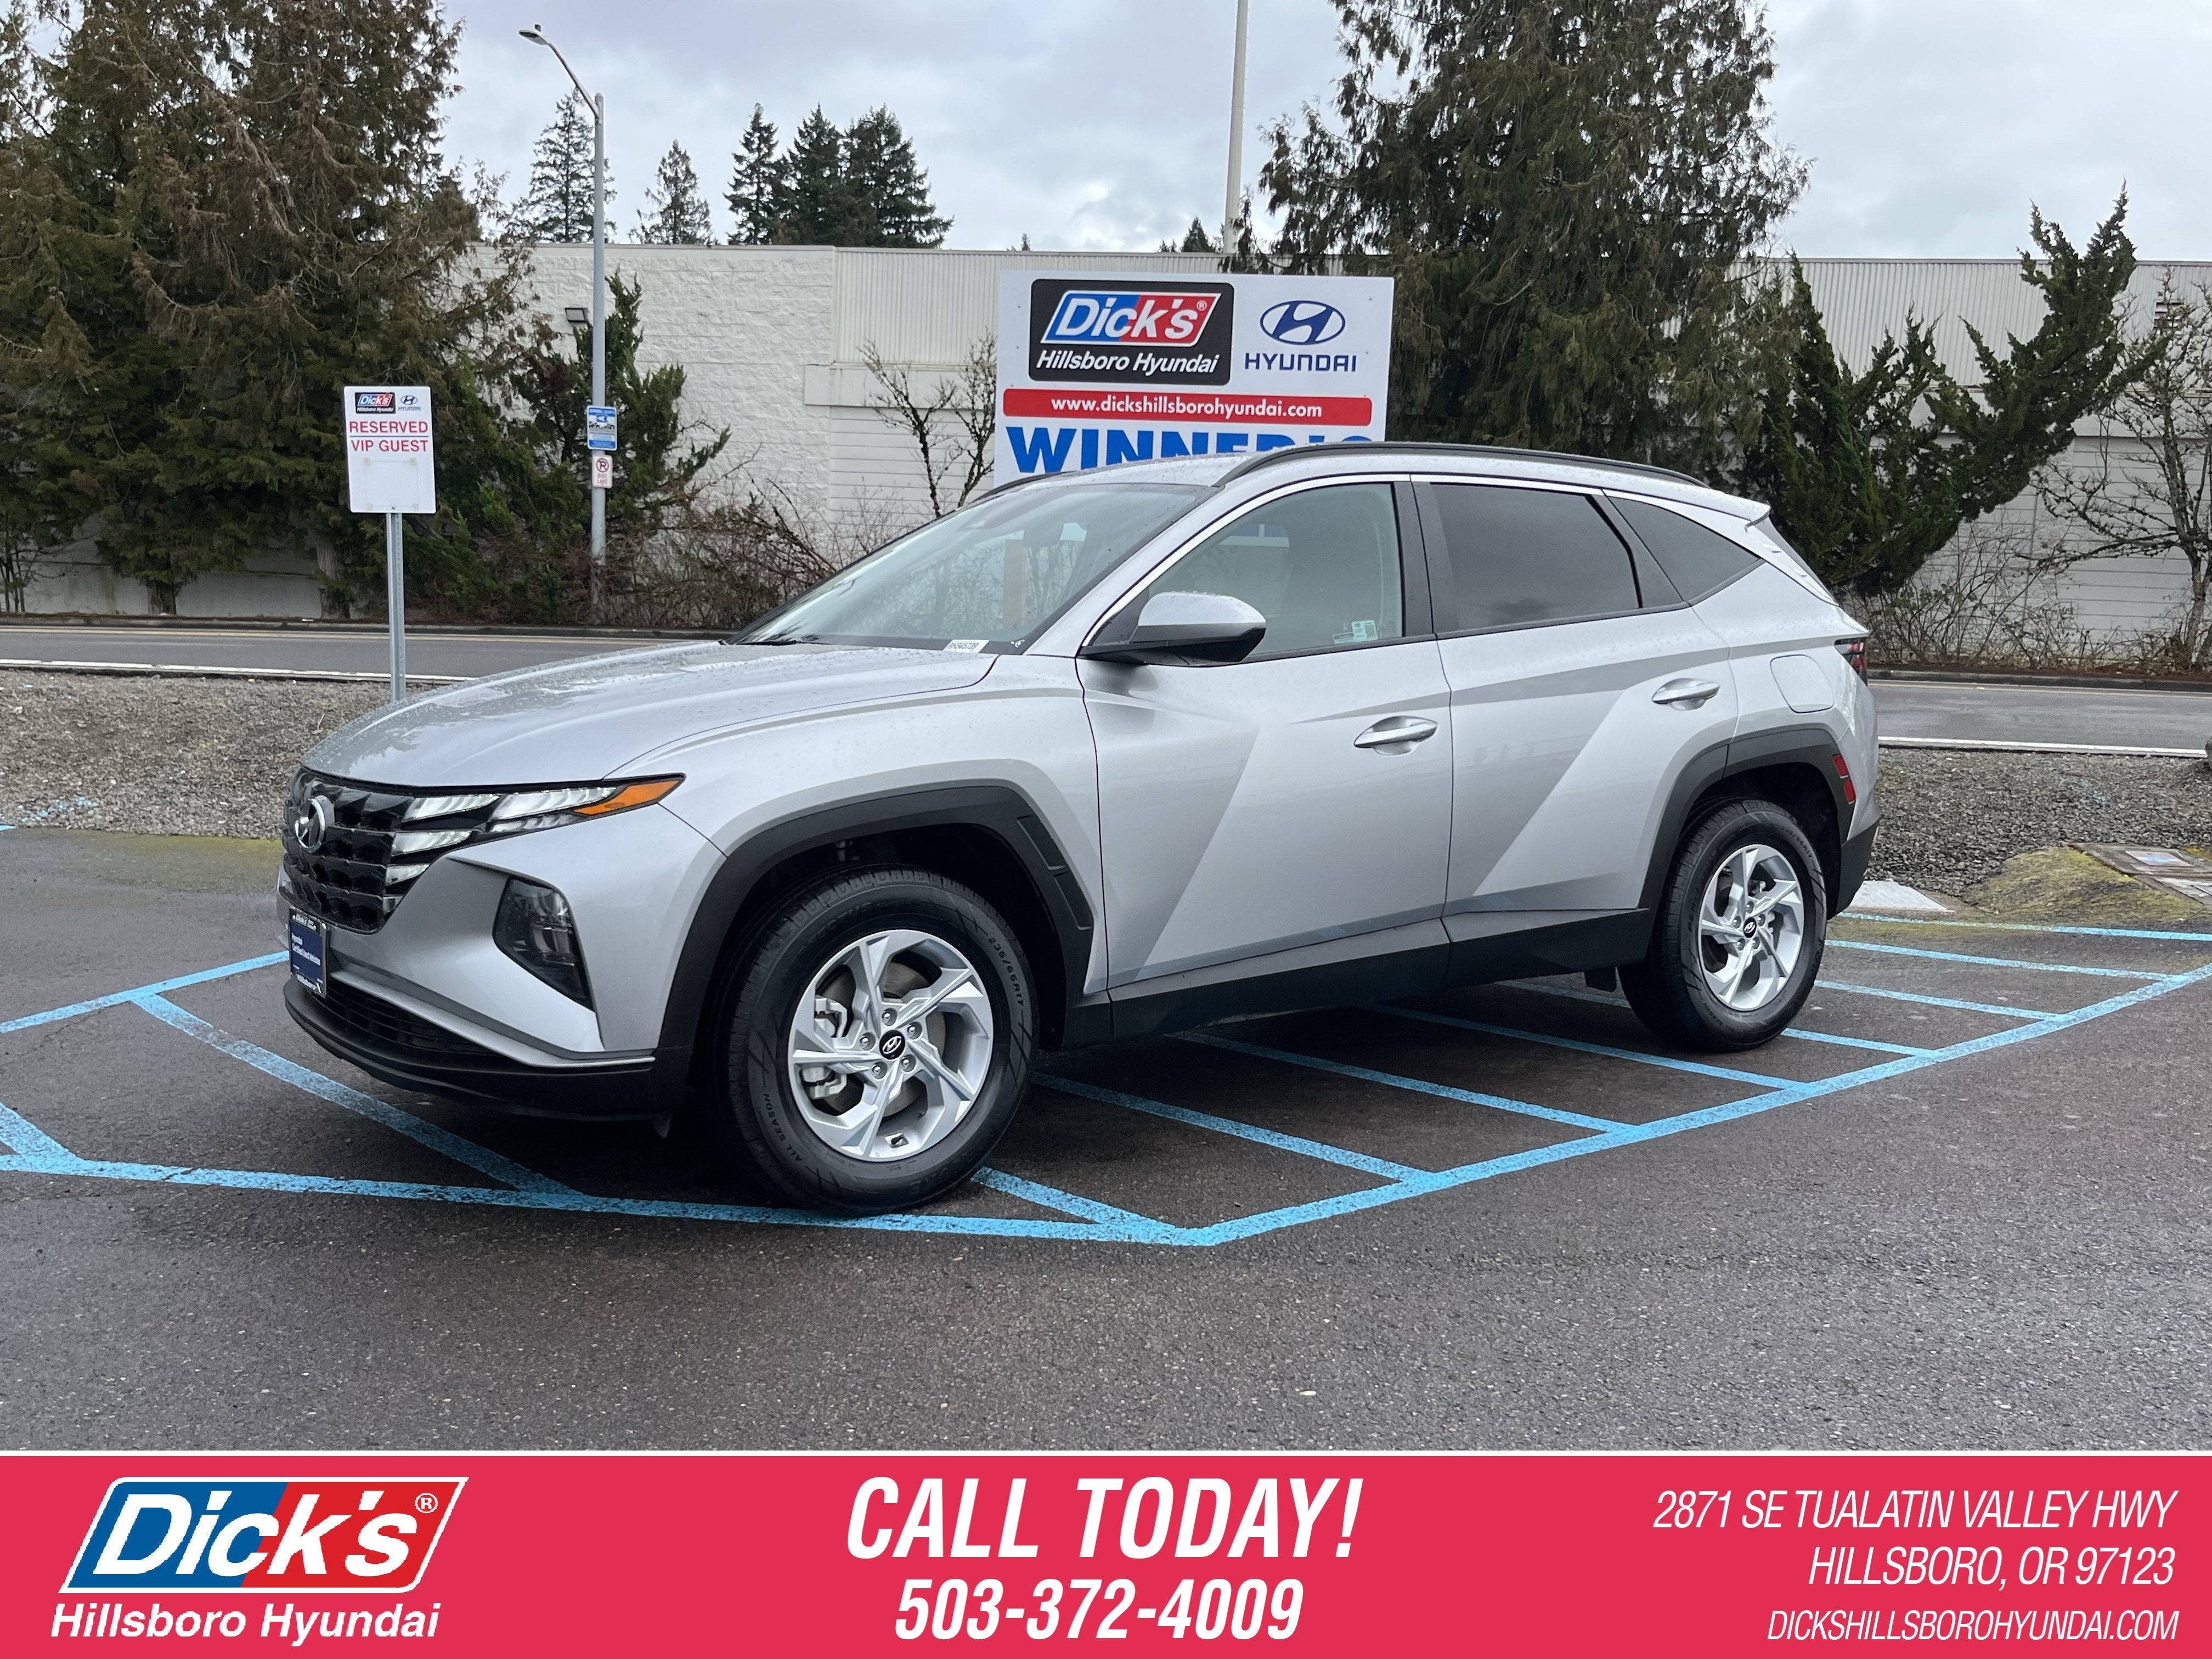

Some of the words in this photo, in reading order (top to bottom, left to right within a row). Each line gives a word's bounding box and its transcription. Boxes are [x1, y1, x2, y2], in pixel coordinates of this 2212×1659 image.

[1056, 296, 1198, 340] Dick's
[1036, 349, 1130, 371] Hillsboro
[1132, 352, 1220, 376] Hyundai
[1245, 352, 1357, 373] HYUNDAI
[360, 395, 390, 405] Dick's
[1052, 394, 1322, 420] www.dickshillsborohyundai.com
[349, 421, 428, 433] RESERVED
[351, 439, 374, 452] VIP
[379, 440, 428, 453] GUEST
[763, 1093, 787, 1142] SEASON
[786, 1143, 803, 1162] ALL
